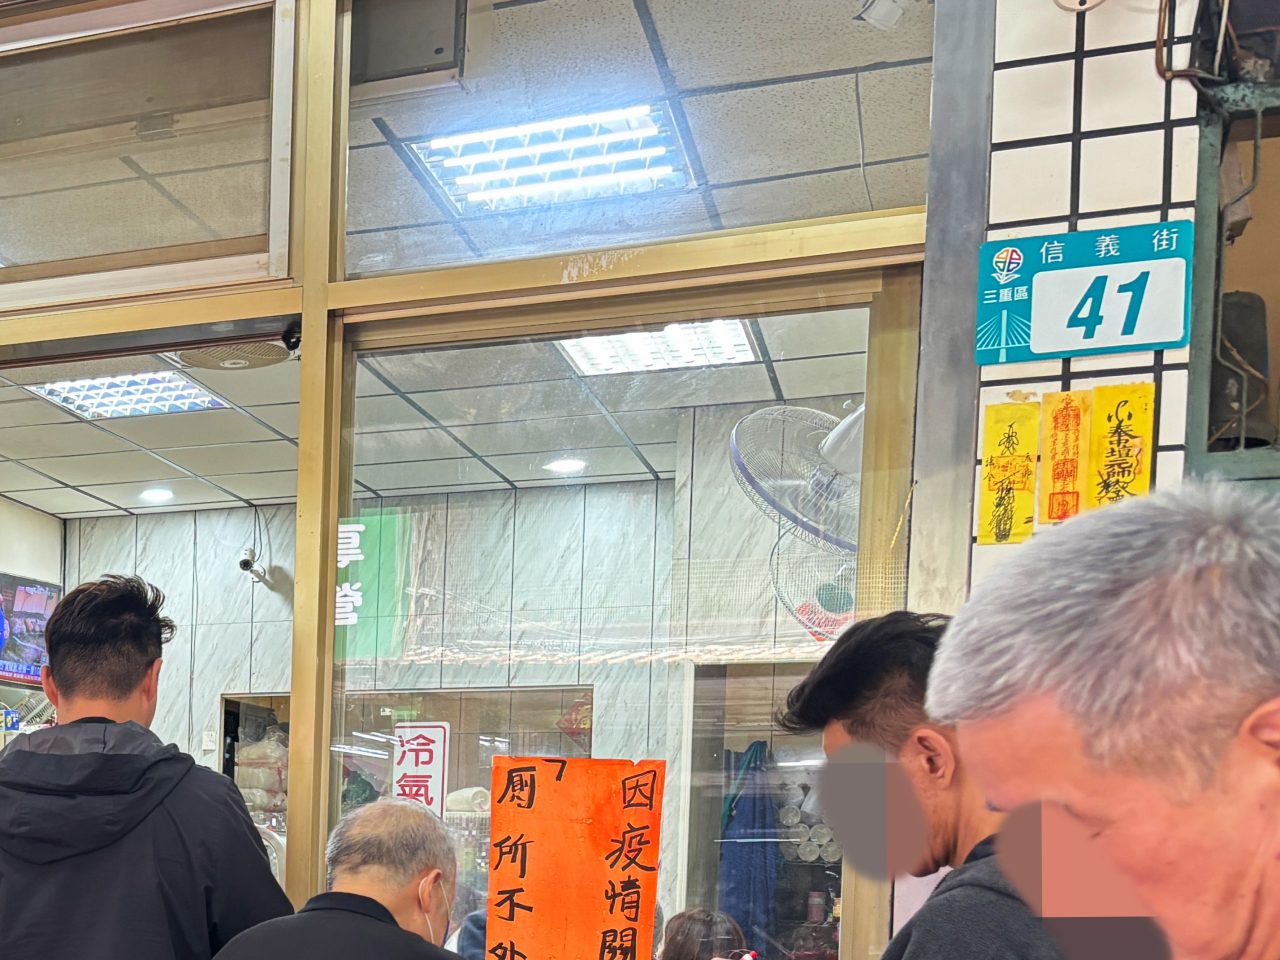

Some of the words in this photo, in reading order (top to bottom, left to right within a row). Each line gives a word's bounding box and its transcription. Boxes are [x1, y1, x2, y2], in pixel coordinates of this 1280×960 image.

[1040, 228, 1179, 264] 信義街
[983, 286, 1029, 303] 三重區
[1066, 271, 1150, 339] 41
[396, 734, 436, 806] 冷氣
